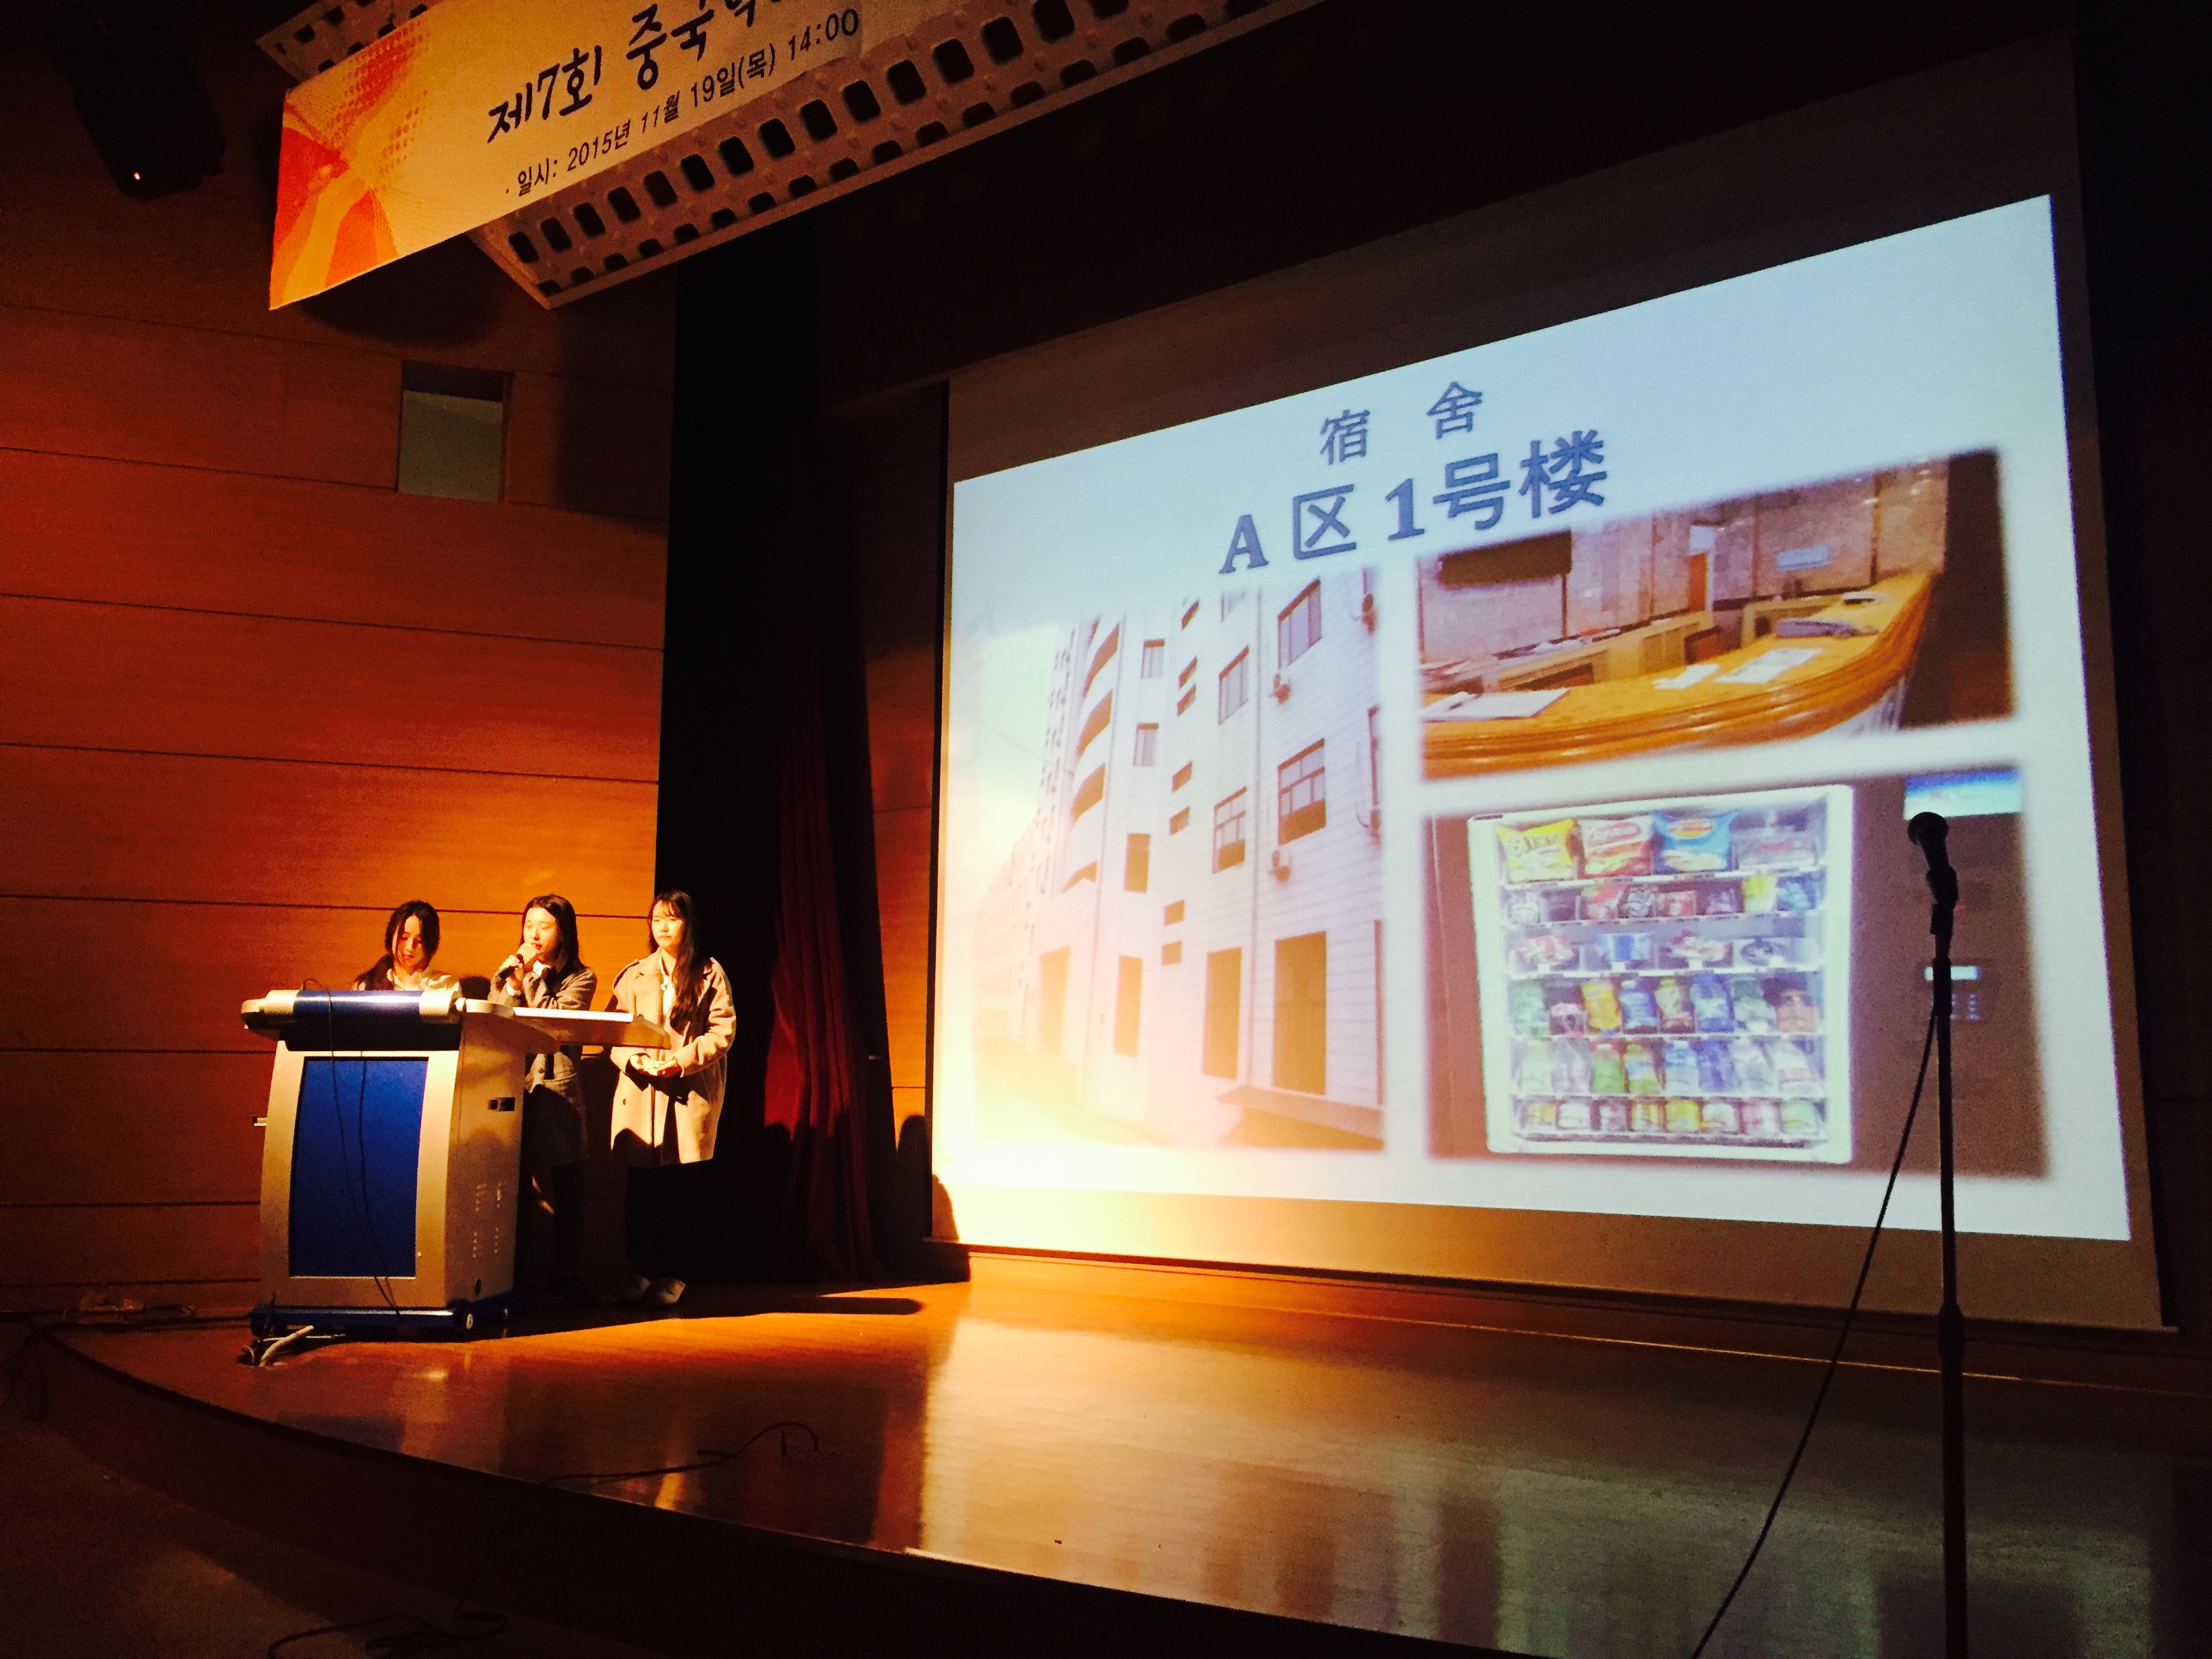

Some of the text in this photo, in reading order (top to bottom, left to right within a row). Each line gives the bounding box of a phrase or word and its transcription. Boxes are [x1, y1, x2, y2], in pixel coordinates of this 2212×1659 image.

[487, 45, 602, 143] 제7회
[518, 8, 859, 197] 일시: 2015년 11월 19일(목) 14:00
